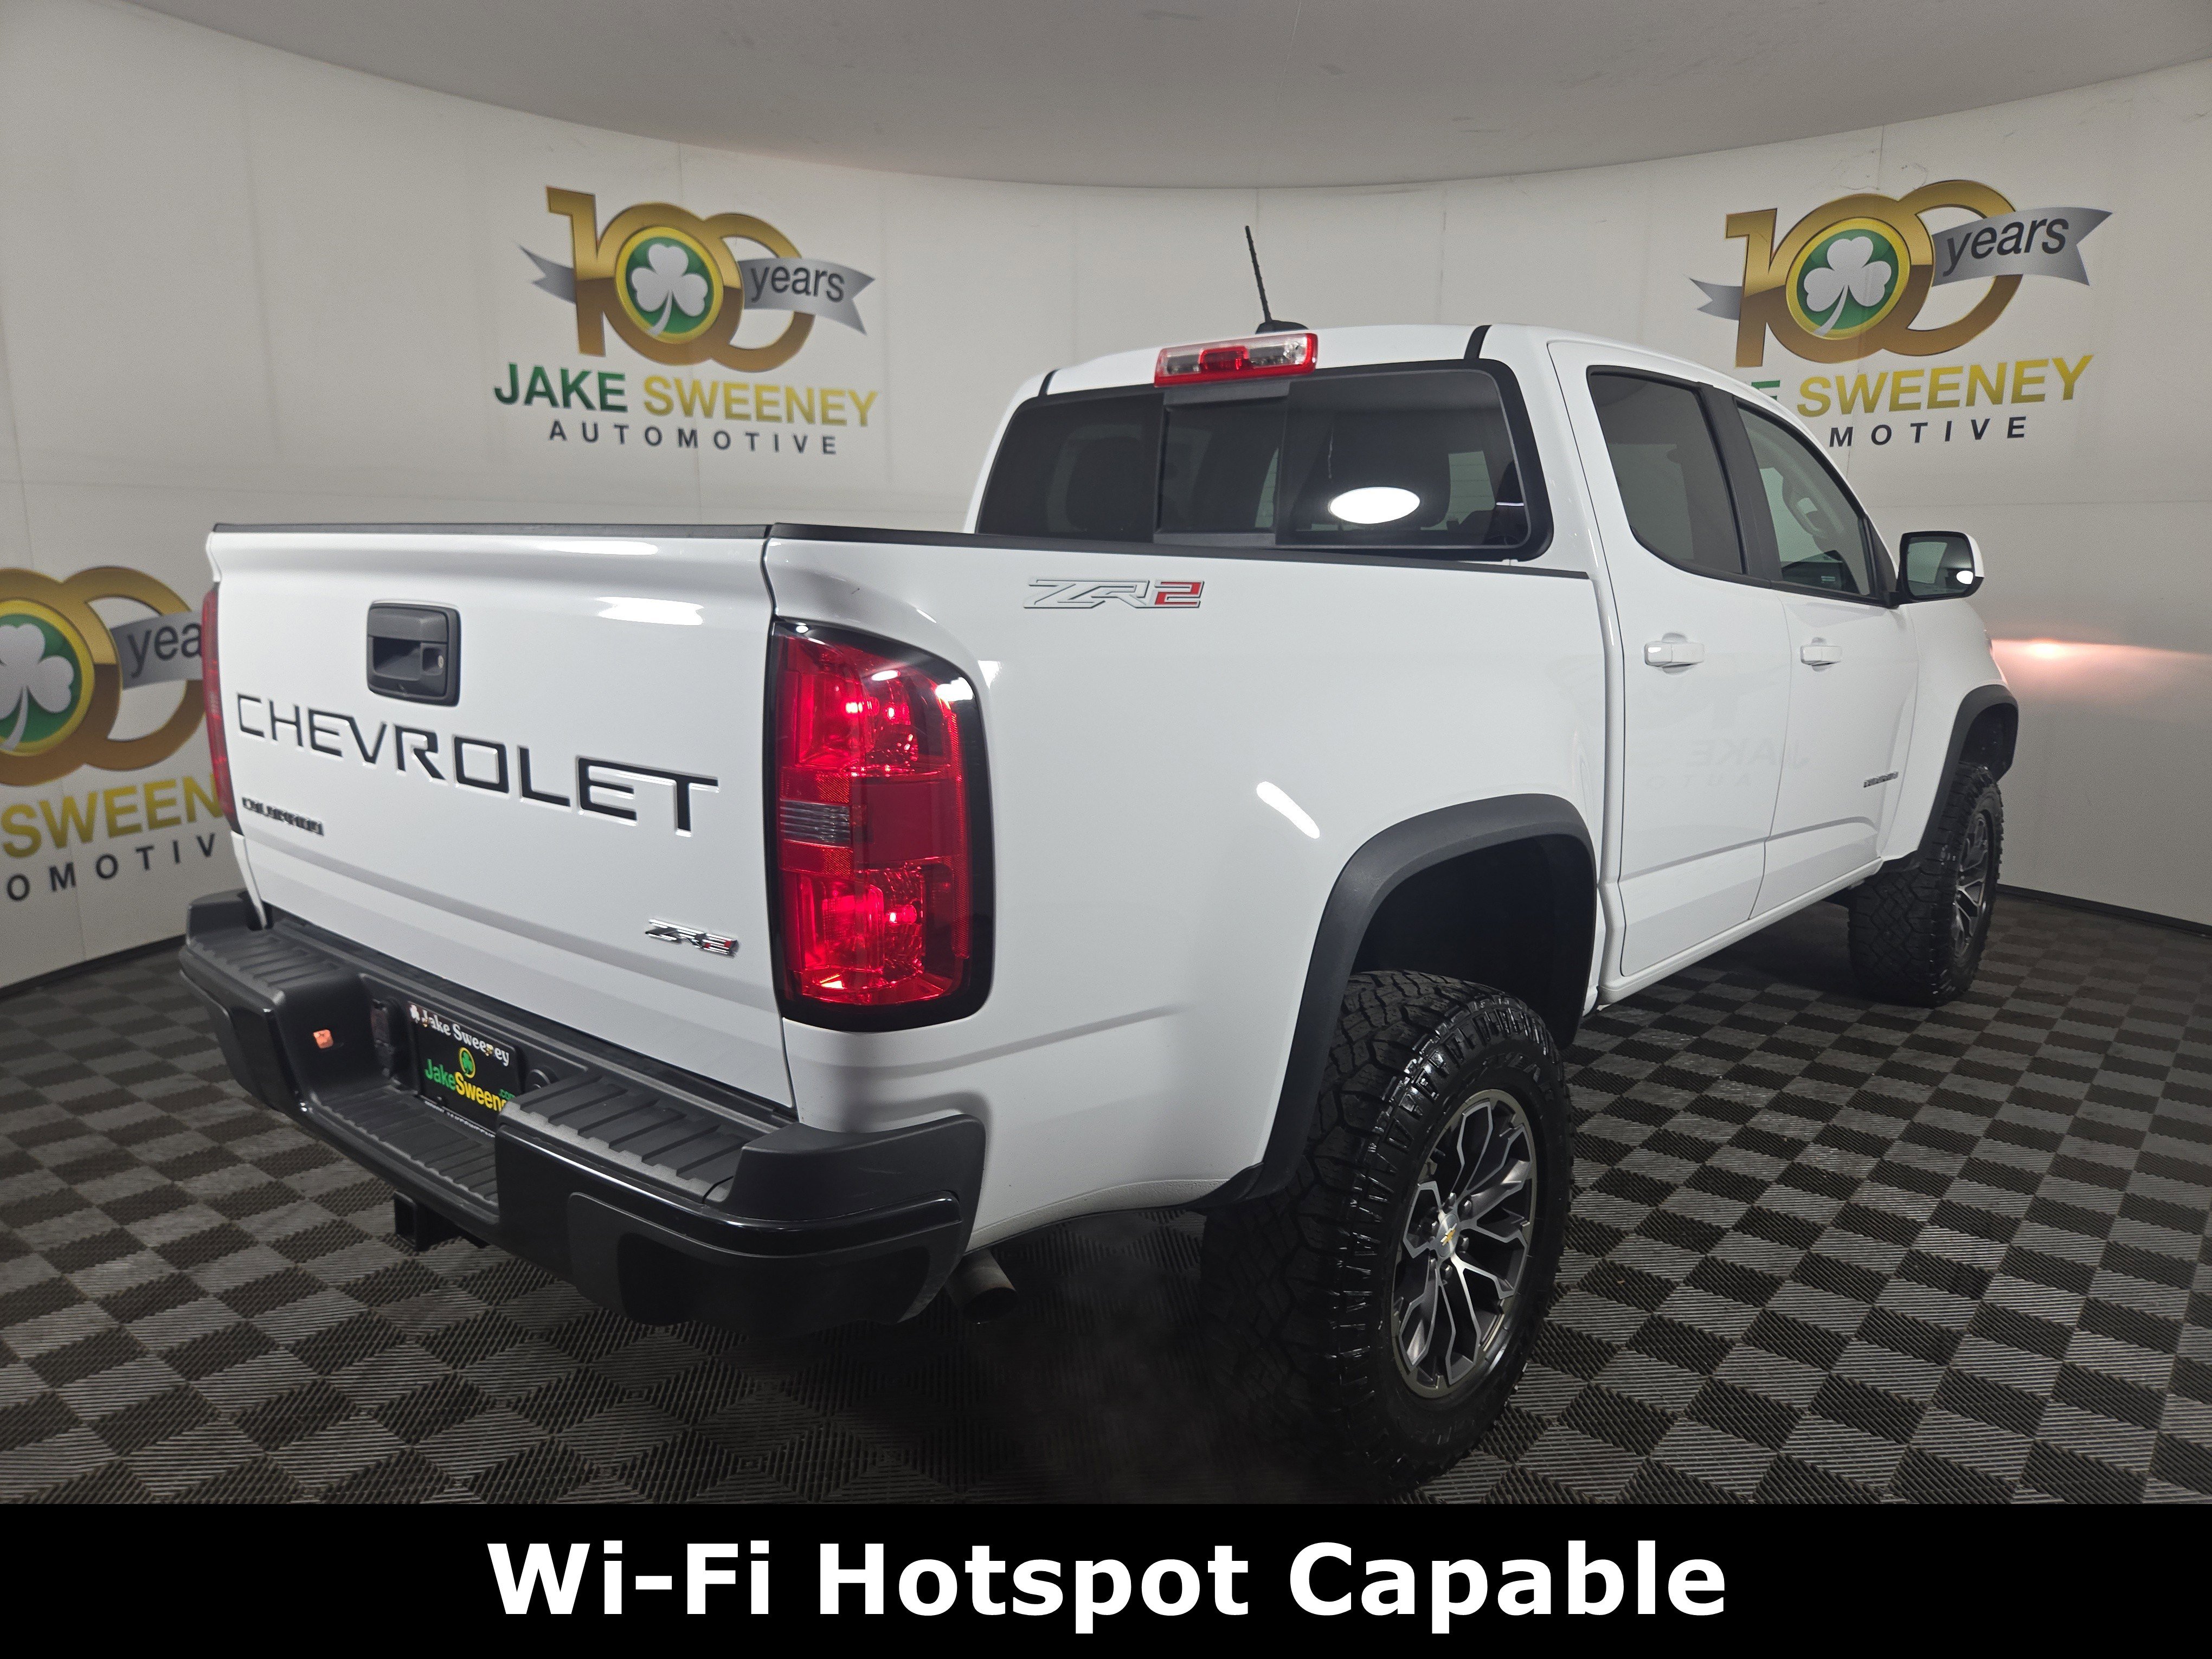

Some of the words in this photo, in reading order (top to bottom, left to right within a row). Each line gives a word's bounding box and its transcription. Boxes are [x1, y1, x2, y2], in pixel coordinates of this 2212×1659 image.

[546, 186, 815, 373] 100
[750, 262, 845, 304] years
[1725, 179, 2024, 368] 100
[1943, 217, 2069, 275] years
[494, 362, 628, 413] JAKE
[644, 375, 878, 427] SWEENEY
[1797, 354, 2094, 418] SWEENEY
[549, 419, 837, 455] AUTOMOTIVE
[1829, 415, 2027, 448] MOTIVE
[1024, 578, 1205, 609] ZR2
[237, 692, 720, 837] CHEVROLET
[421, 1009, 452, 1036] Jake
